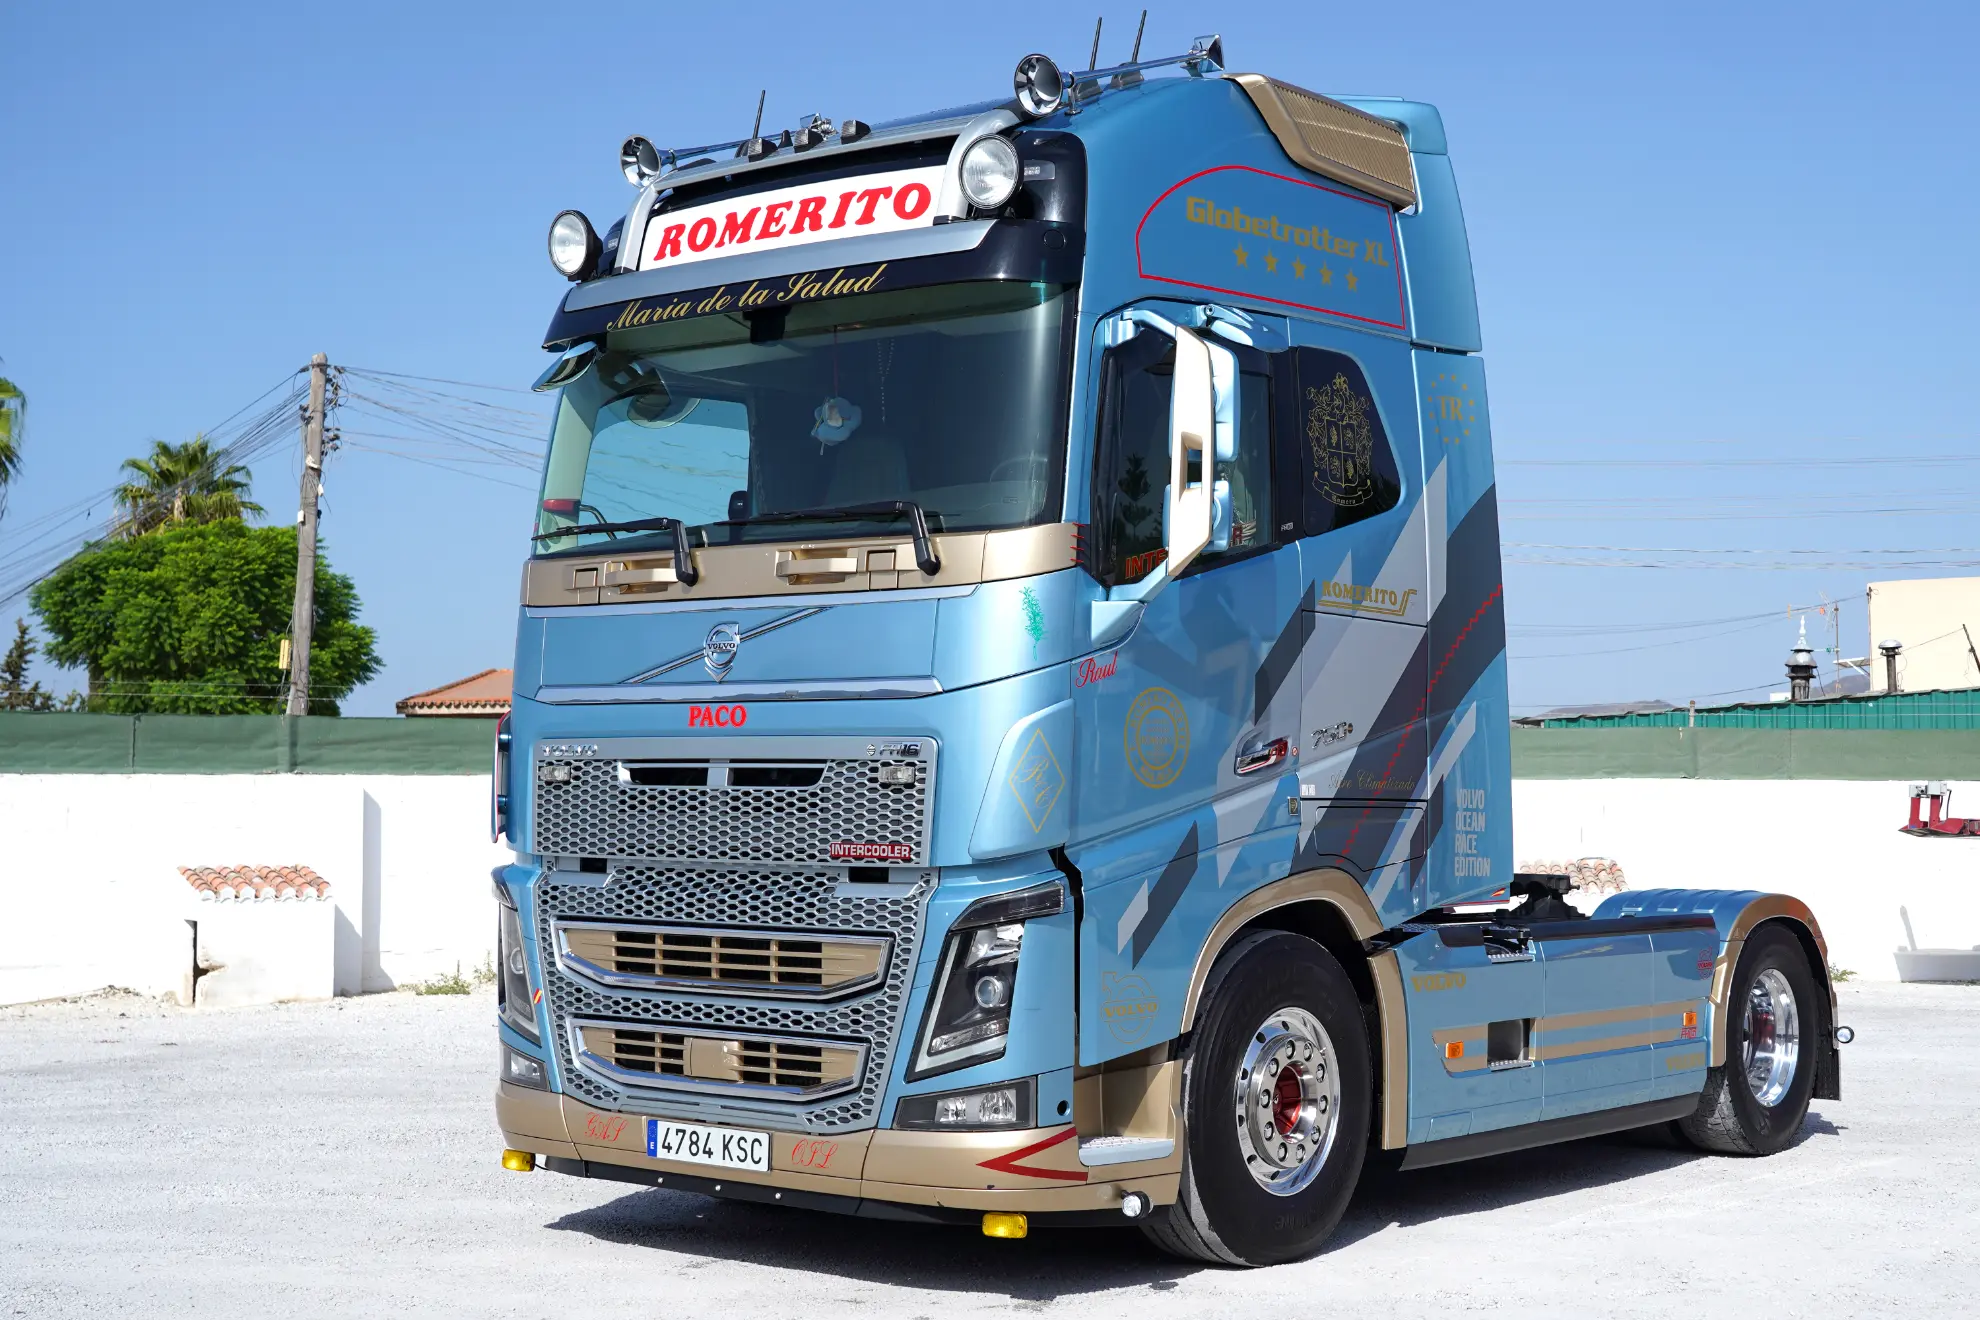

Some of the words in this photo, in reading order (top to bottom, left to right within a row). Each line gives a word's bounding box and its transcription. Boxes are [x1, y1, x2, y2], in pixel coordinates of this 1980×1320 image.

[653, 183, 932, 261] ROMERITO
[1186, 196, 1359, 259] Globetrotter
[1363, 239, 1389, 268] XL
[606, 298, 697, 331] Maria
[696, 287, 737, 313] de
[738, 282, 777, 308] la
[777, 264, 888, 302] Salud
[1436, 396, 1463, 420] TR
[1322, 580, 1398, 606] ROMERITO
[707, 642, 736, 650] VOLVO
[1075, 649, 1119, 688] Raul
[688, 704, 747, 728] PACO
[541, 744, 598, 757] VOLVO
[880, 742, 920, 757] FH16
[1456, 789, 1485, 809] VOLVO
[1455, 810, 1486, 832] OCEAN
[831, 843, 910, 858] INTERCOOLER
[1455, 833, 1478, 854] RACE
[1454, 857, 1491, 877] EDITION
[1411, 973, 1467, 992] VOLVO
[1104, 1002, 1157, 1018] VOLVO
[661, 1127, 714, 1158] 4784
[722, 1134, 763, 1165] KSC
